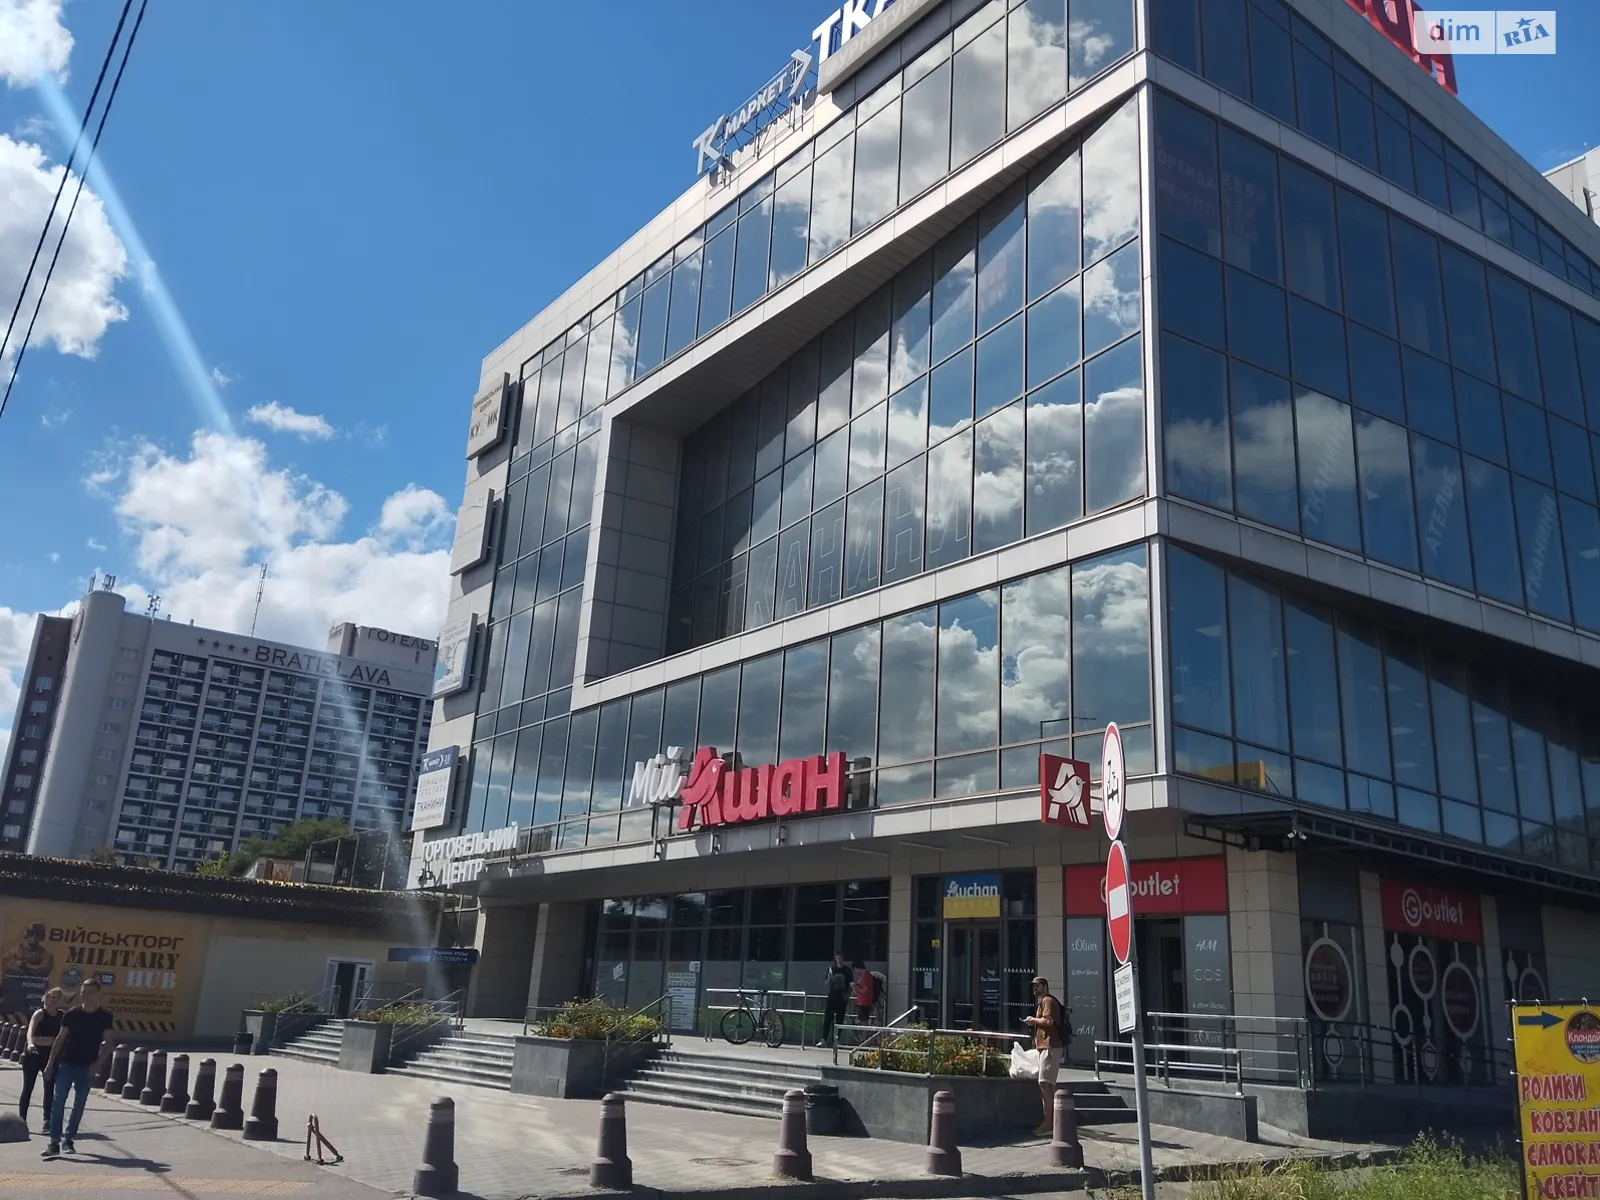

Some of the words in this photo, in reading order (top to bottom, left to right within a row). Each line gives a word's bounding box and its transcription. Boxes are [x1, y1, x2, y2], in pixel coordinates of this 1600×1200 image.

[725, 74, 790, 139] МАРКЕТ
[367, 627, 430, 651] ГОТЕЛЬ
[254, 645, 391, 686] BRATISLAVA
[628, 745, 688, 807] Мій
[677, 746, 846, 829] Ашан
[421, 820, 519, 862] ТОРГОВЕЛЬНИЙ
[441, 858, 486, 889] ЦЕНТР
[945, 880, 999, 898] Auchan
[48, 926, 185, 951] ВІЙСЬКТОРГ
[65, 945, 181, 971] MILITARY
[125, 969, 178, 990] HUB
[1193, 968, 1223, 982] COS
[1521, 1073, 1586, 1104] РОЛИКИ
